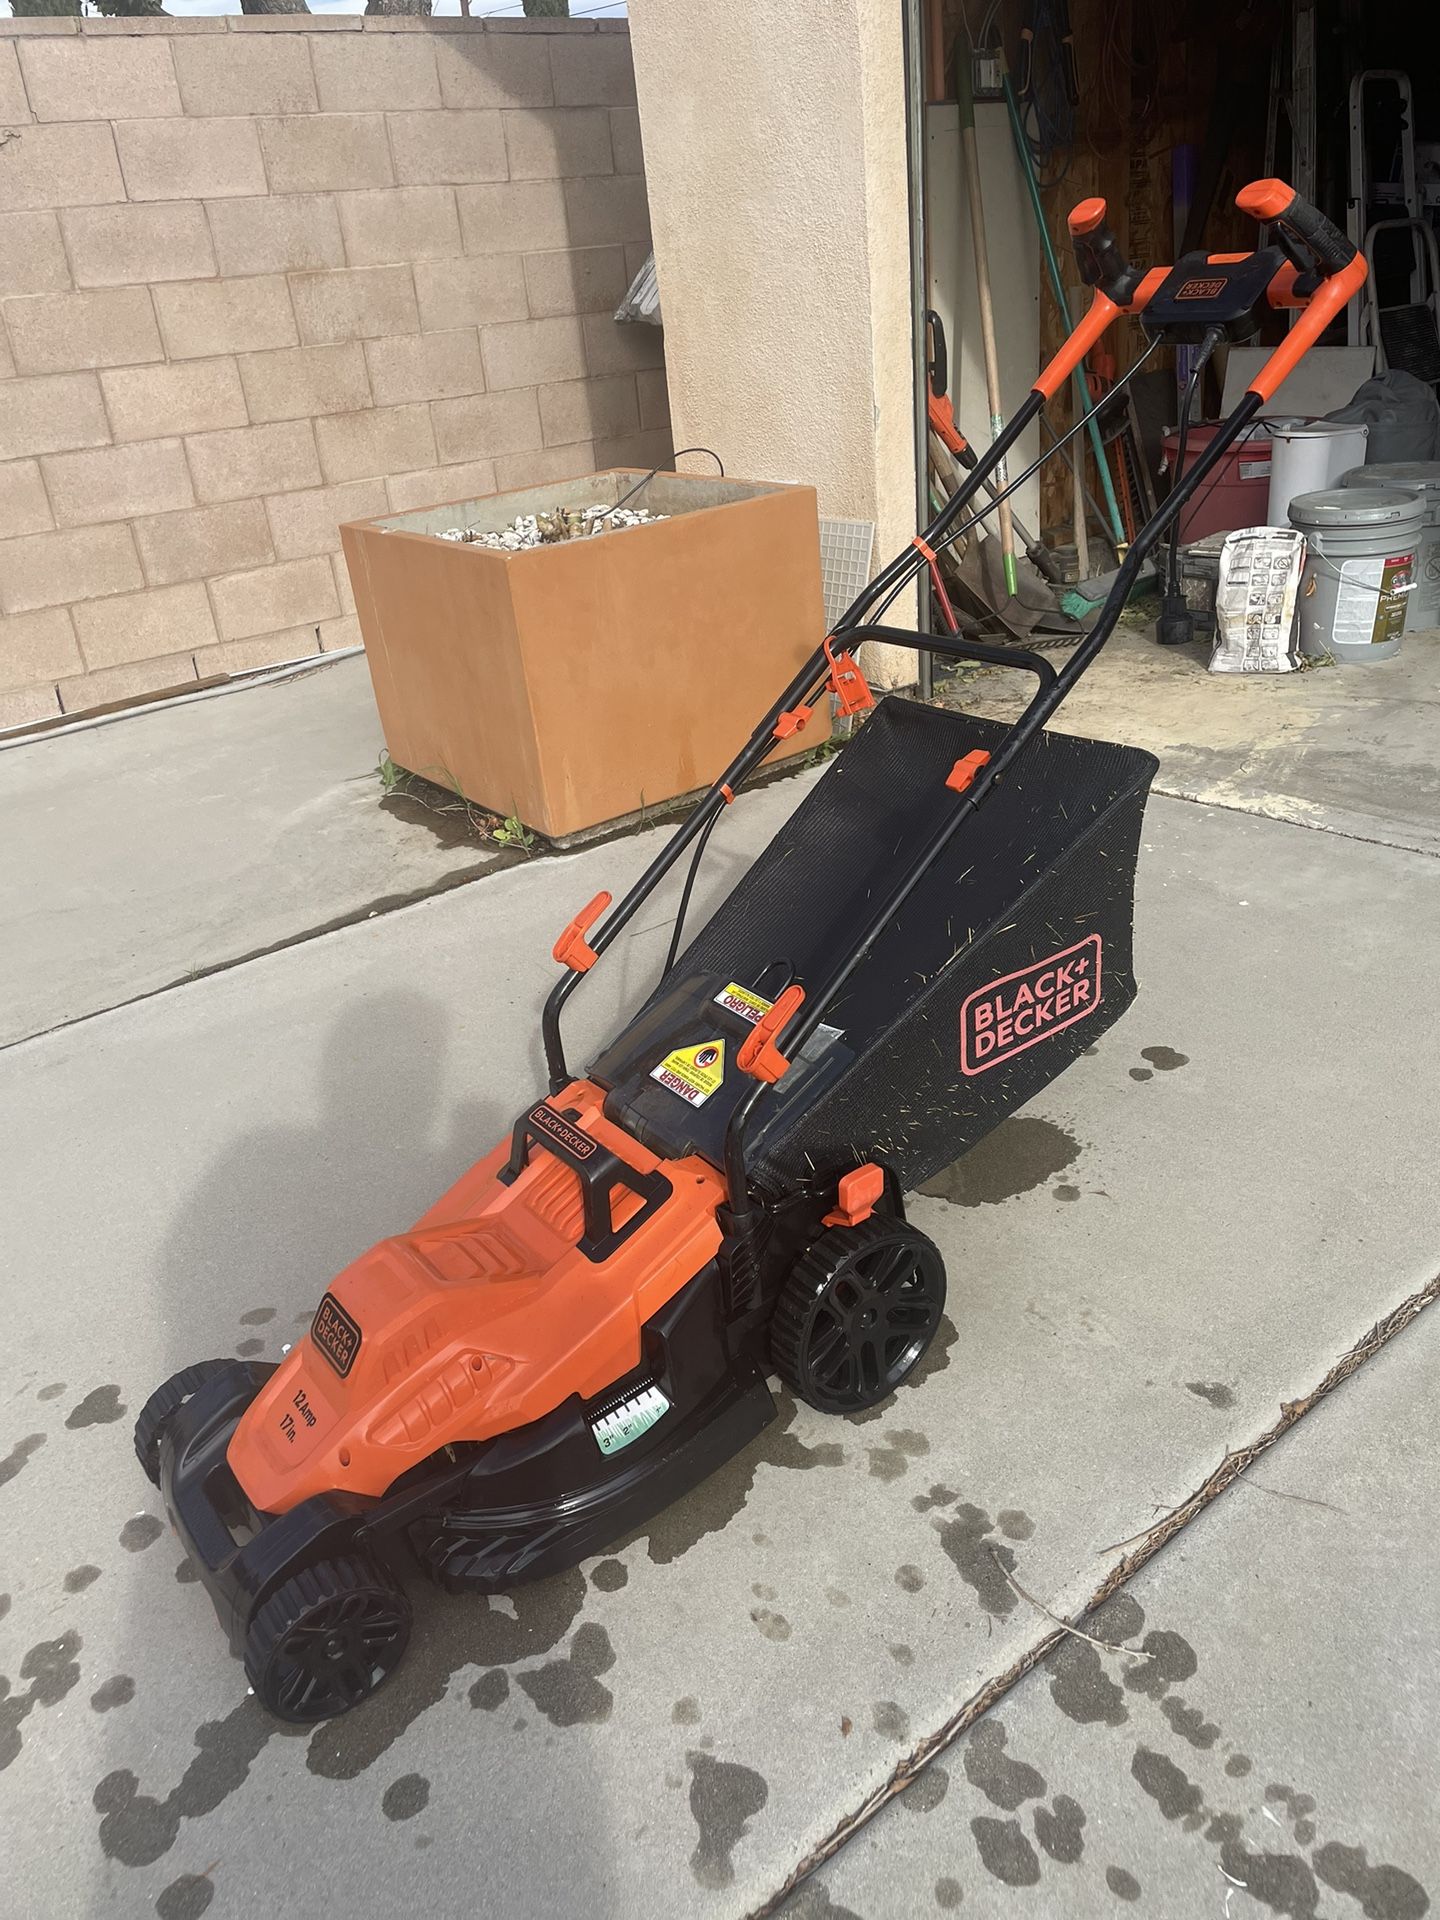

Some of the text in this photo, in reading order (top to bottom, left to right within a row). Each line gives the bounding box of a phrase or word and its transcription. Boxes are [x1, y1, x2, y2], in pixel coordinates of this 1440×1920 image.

[1185, 281, 1222, 289] DECKER
[723, 995, 766, 1023] PELIGRO
[974, 957, 1089, 1032] BLACK+
[975, 978, 1090, 1059] DECKER
[659, 1070, 700, 1101] DANGER
[534, 1110, 591, 1154] BLACK+DECKER
[317, 1321, 350, 1364] DECKER
[322, 1306, 353, 1347] BLACK+
